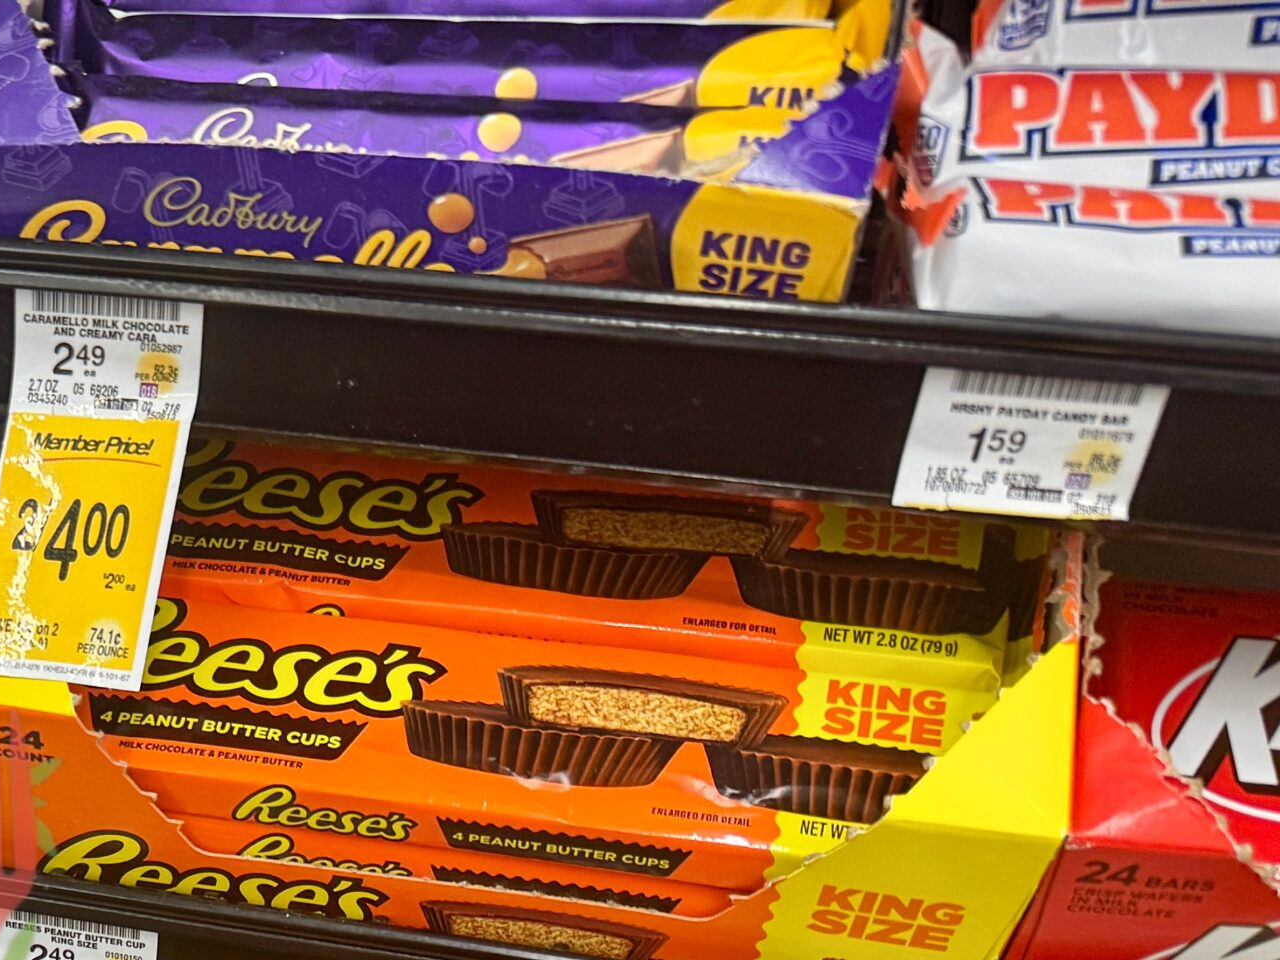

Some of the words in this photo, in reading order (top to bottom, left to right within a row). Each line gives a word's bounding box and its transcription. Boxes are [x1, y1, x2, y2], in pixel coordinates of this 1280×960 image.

[142, 175, 324, 249] Cadbury
[699, 229, 812, 270] KING
[698, 262, 805, 300] SIZE
[23, 314, 89, 328] CARAMELLO
[91, 318, 121, 330] MILK
[123, 320, 190, 336] CHOCOLATE
[53, 326, 78, 338] AND
[80, 328, 125, 341] CREAMY
[127, 331, 158, 344] CARA
[998, 405, 1049, 420] PAYDAY
[1052, 410, 1100, 425] CANDY
[1101, 414, 1129, 427] BAR
[34, 432, 105, 454] Member
[104, 435, 155, 456] Price!
[823, 627, 848, 645] NET
[851, 629, 874, 647] WT
[876, 631, 898, 650] 2.8
[900, 634, 918, 652] OZ
[100, 710, 114, 726] 4
[116, 710, 195, 734] PEANUT
[198, 717, 282, 741] BUTTER
[286, 731, 343, 750] CUPS
[234, 785, 418, 840] Reese's
[817, 884, 967, 926] KING
[5, 921, 42, 934] REESES
[44, 926, 83, 940] PEANUT
[85, 933, 125, 947] BUTTER
[126, 939, 146, 950] CUP
[51, 935, 74, 945] KING
[76, 939, 98, 950] SIZE
[806, 909, 966, 952] SIZE
